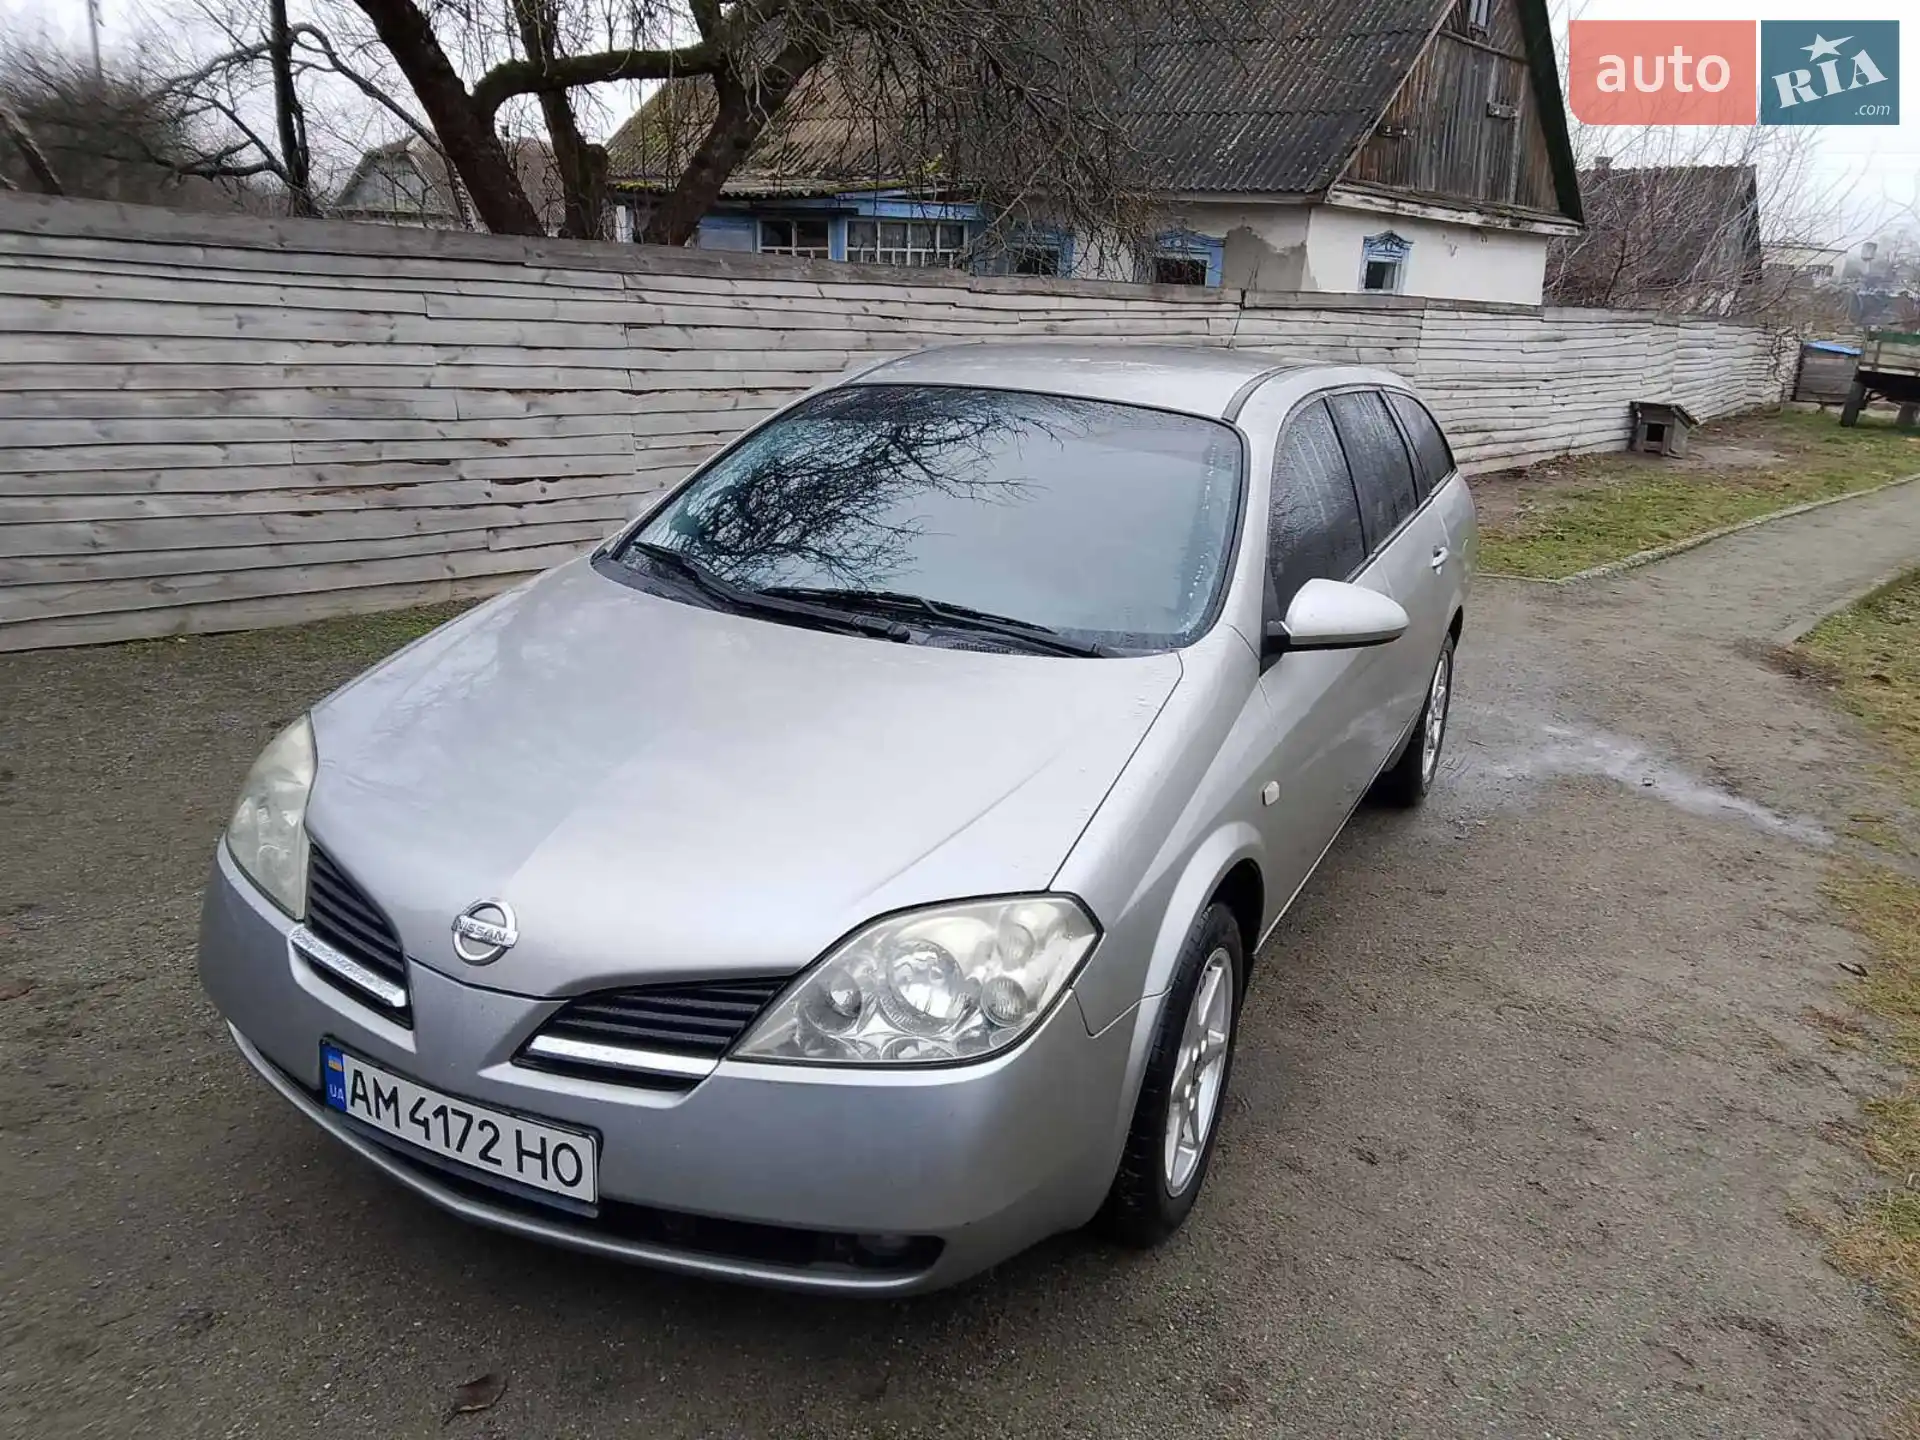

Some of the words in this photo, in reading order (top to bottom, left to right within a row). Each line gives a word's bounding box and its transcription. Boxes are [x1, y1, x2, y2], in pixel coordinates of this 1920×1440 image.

[458, 919, 508, 942] NISSAN
[329, 1083, 345, 1101] UA
[350, 1069, 401, 1128] AM
[409, 1097, 502, 1166] 4172
[515, 1129, 583, 1188] HO
